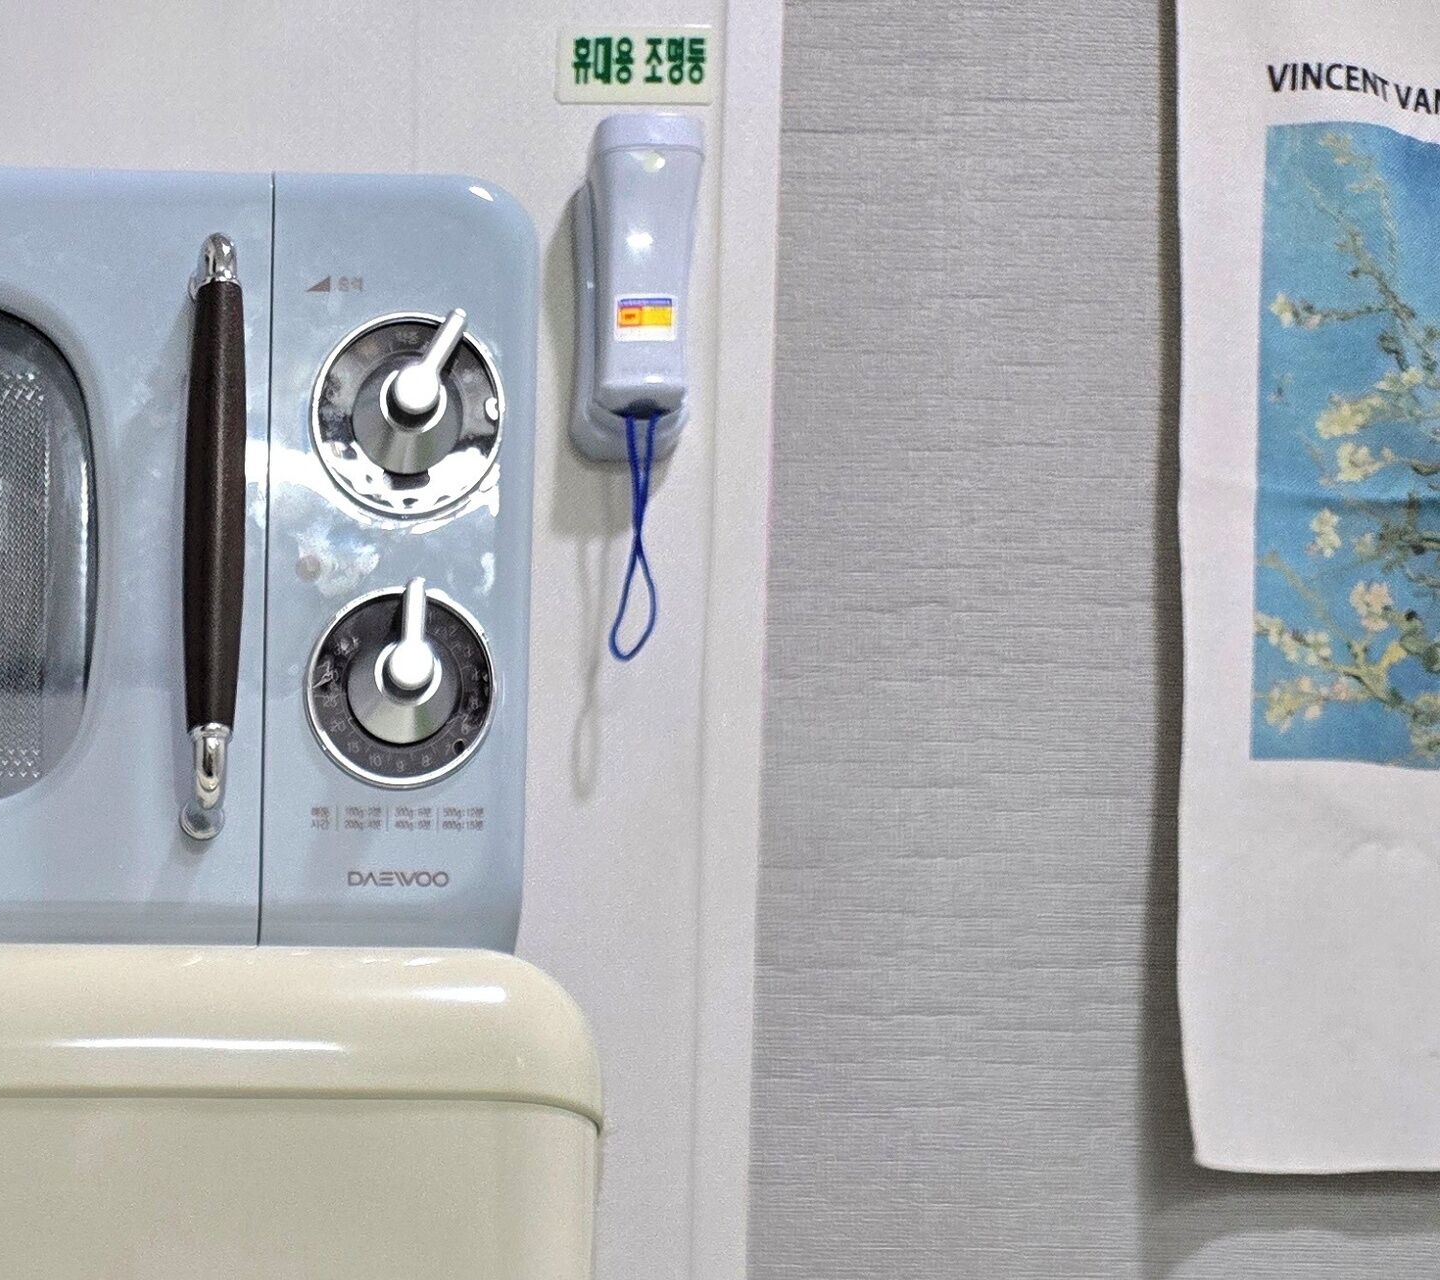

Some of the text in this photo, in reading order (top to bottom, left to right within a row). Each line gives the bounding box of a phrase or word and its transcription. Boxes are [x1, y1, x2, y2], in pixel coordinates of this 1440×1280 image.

[572, 37, 707, 85] 휴대용 조명등
[1267, 62, 1440, 115] VINCENT VA
[347, 870, 450, 888] DAEWOO
